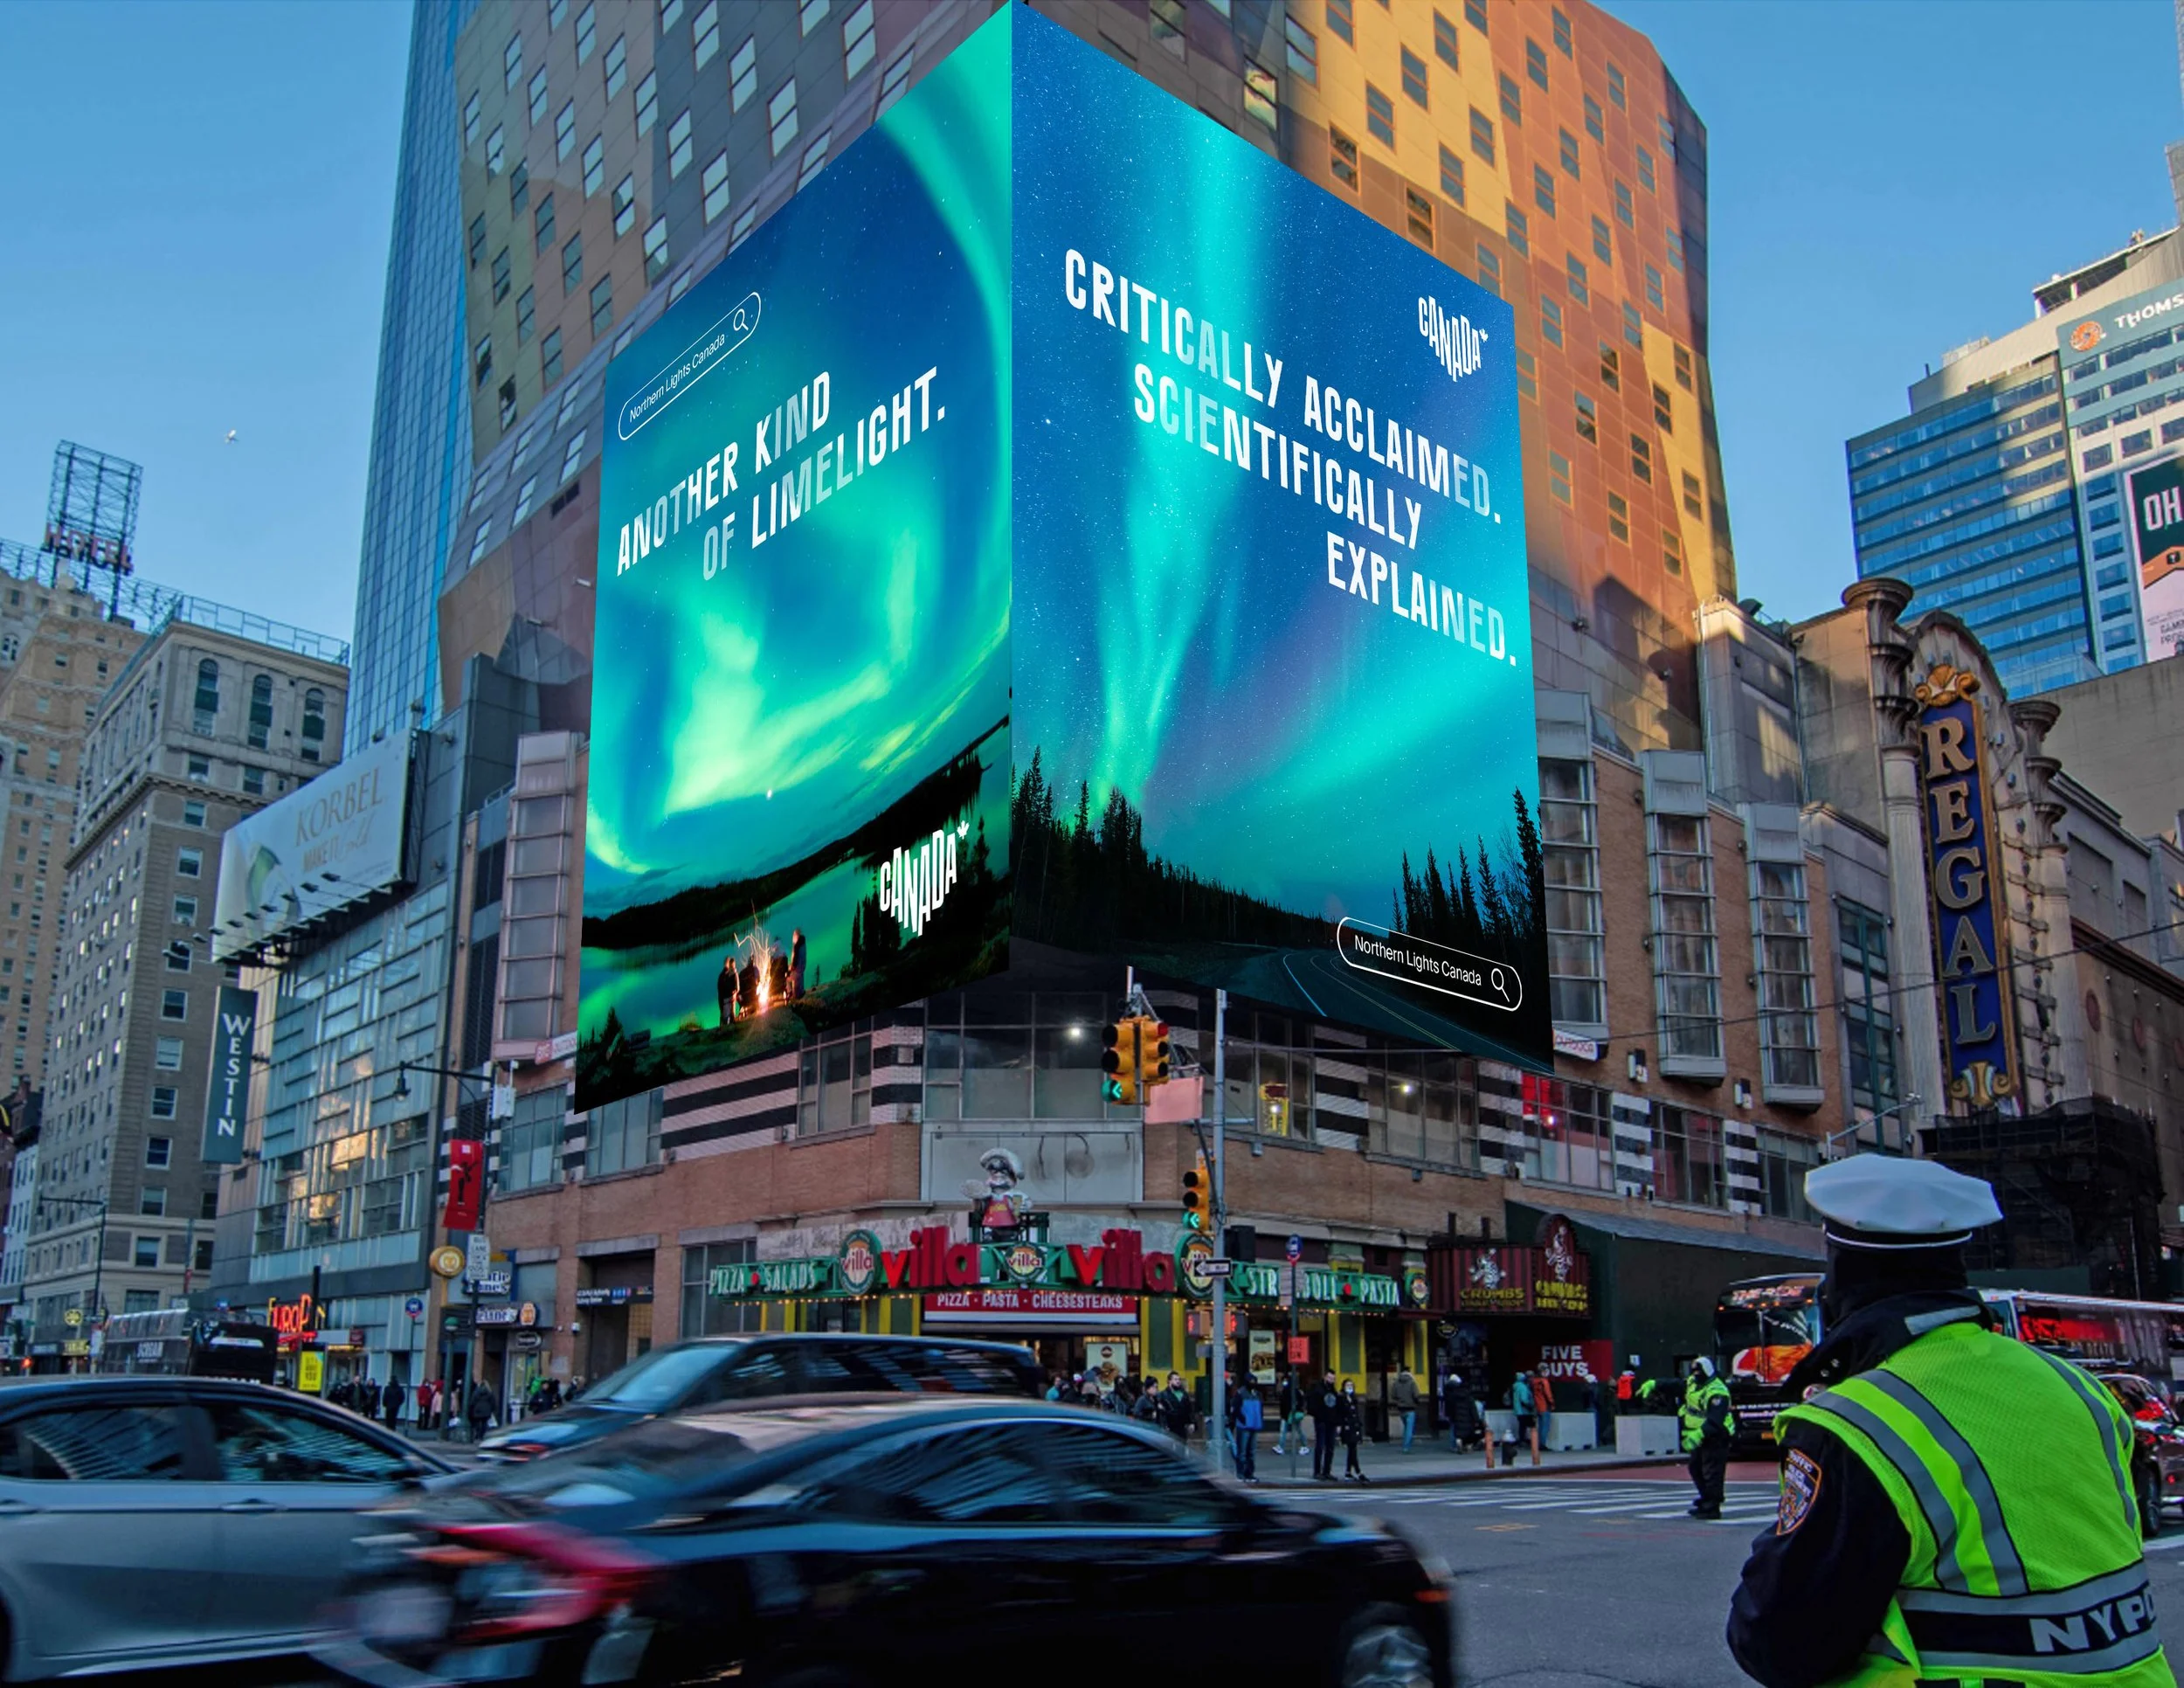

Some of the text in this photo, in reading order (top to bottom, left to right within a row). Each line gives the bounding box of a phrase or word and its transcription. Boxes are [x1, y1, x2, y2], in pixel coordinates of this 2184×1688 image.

[629, 334, 725, 423] Northern Lights Canada
[1418, 295, 1482, 382] CANADA
[1065, 248, 1502, 524] CRITICALLY ACCLAIMED.
[617, 371, 830, 577] ANOTHER KIND
[703, 366, 945, 581] OF LIMELIGHT.
[1135, 363, 1422, 550] SCIENTIFICALLY
[1327, 531, 1517, 666] EXPLAINED.
[295, 766, 383, 847] KORBEL
[880, 829, 957, 937] CANADA
[1923, 716, 1995, 1043] REGAL
[1355, 934, 1482, 986] Northern Lights Canada
[218, 1013, 252, 1136] WESTIN
[708, 1267, 744, 1295] PIZZA
[764, 1263, 816, 1292] SALADS
[842, 1247, 874, 1271] villa
[881, 1225, 981, 1288] villa
[1007, 1251, 1041, 1267] villa
[1067, 1228, 1179, 1292] villa
[1359, 1279, 1400, 1305] PASTA
[937, 1292, 1123, 1309] PIZZA PASTA CHEESESTEAKS
[1538, 1361, 1589, 1378] GUYS
[1541, 1346, 1582, 1359] FIVE
